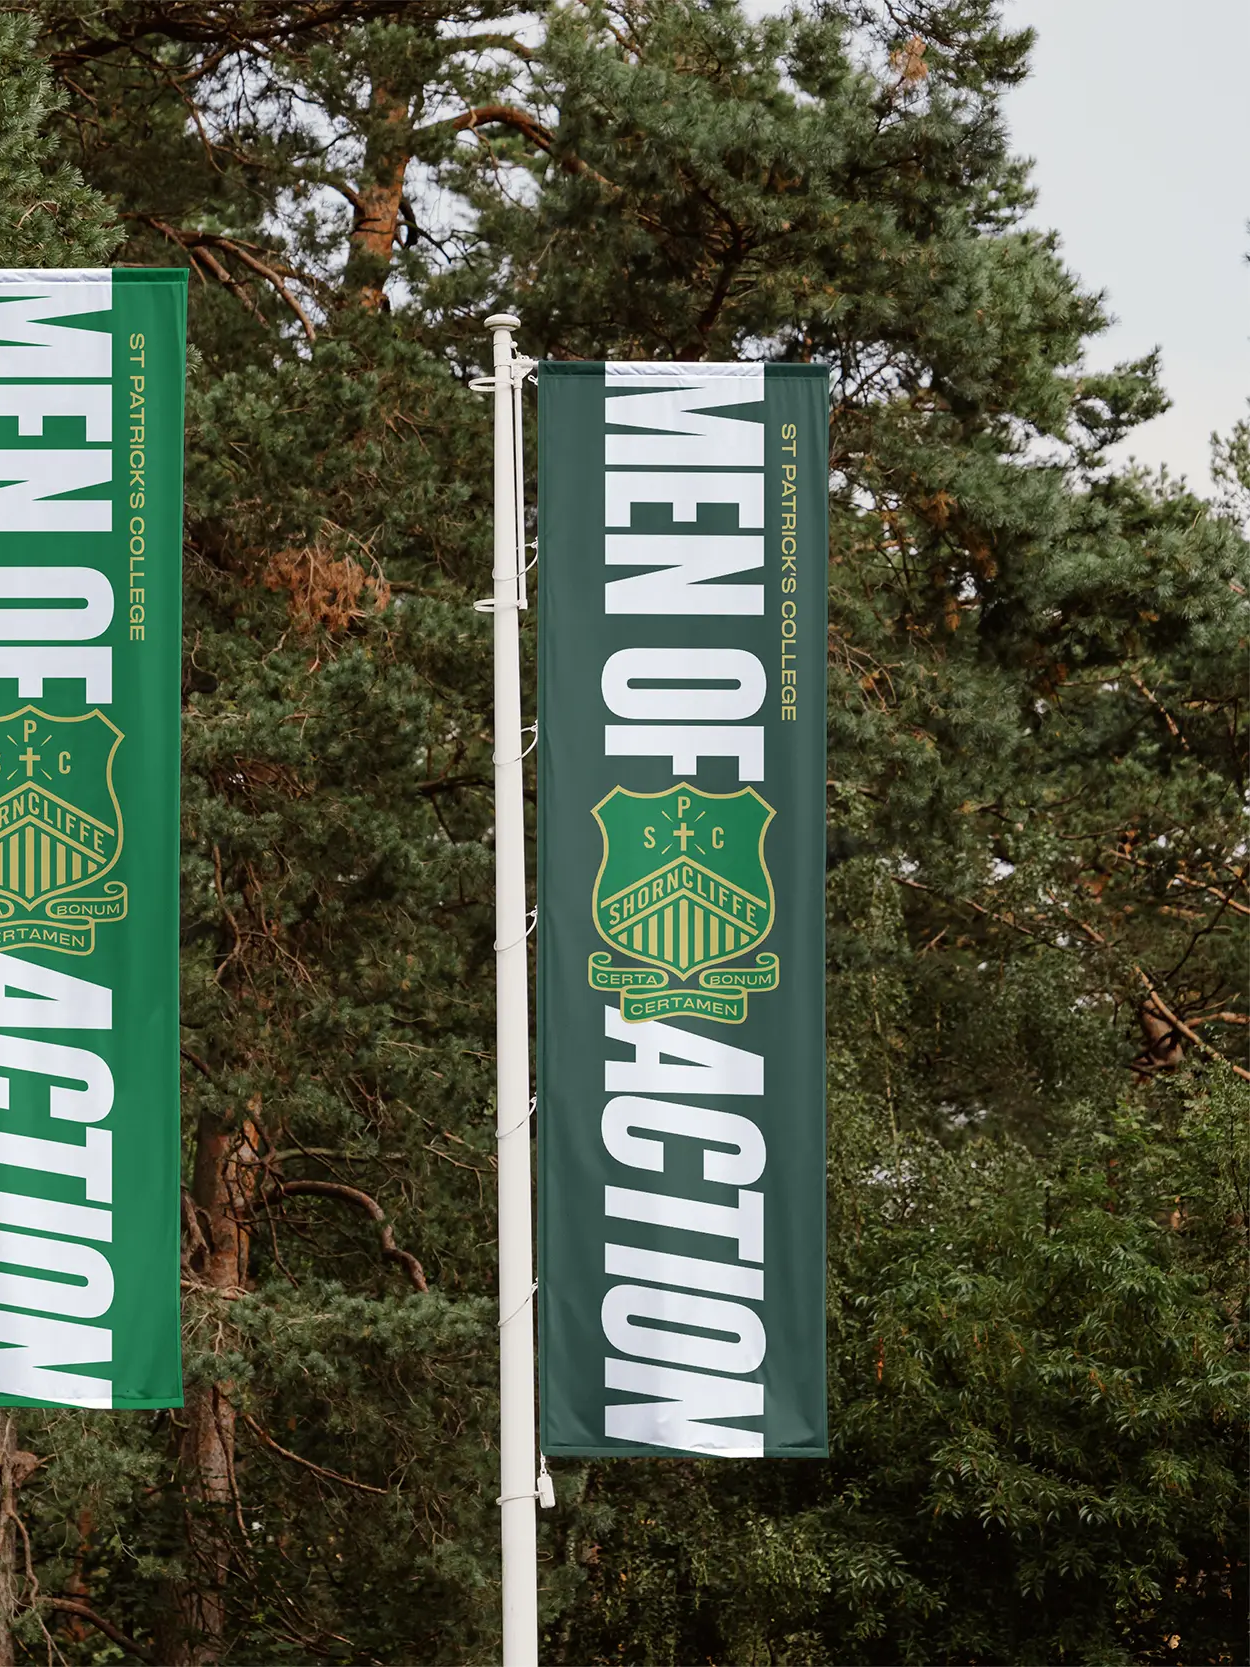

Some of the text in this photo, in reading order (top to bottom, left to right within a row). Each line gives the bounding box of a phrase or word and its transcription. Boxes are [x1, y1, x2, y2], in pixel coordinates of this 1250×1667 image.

[129, 332, 145, 641] ST PATRICK'S COLLEGE
[781, 423, 797, 721] ST PATRICK'S COLLEGE
[23, 719, 37, 743] P
[58, 751, 71, 775] C
[677, 796, 691, 818] P
[643, 826, 725, 849] S C
[609, 866, 757, 927] SHORNCLIFFE
[56, 903, 120, 916] BONUM
[601, 361, 767, 1458] MEN OF ACTION
[596, 973, 772, 985] CERTA BONUM
[630, 997, 737, 1016] CERTAMEN
